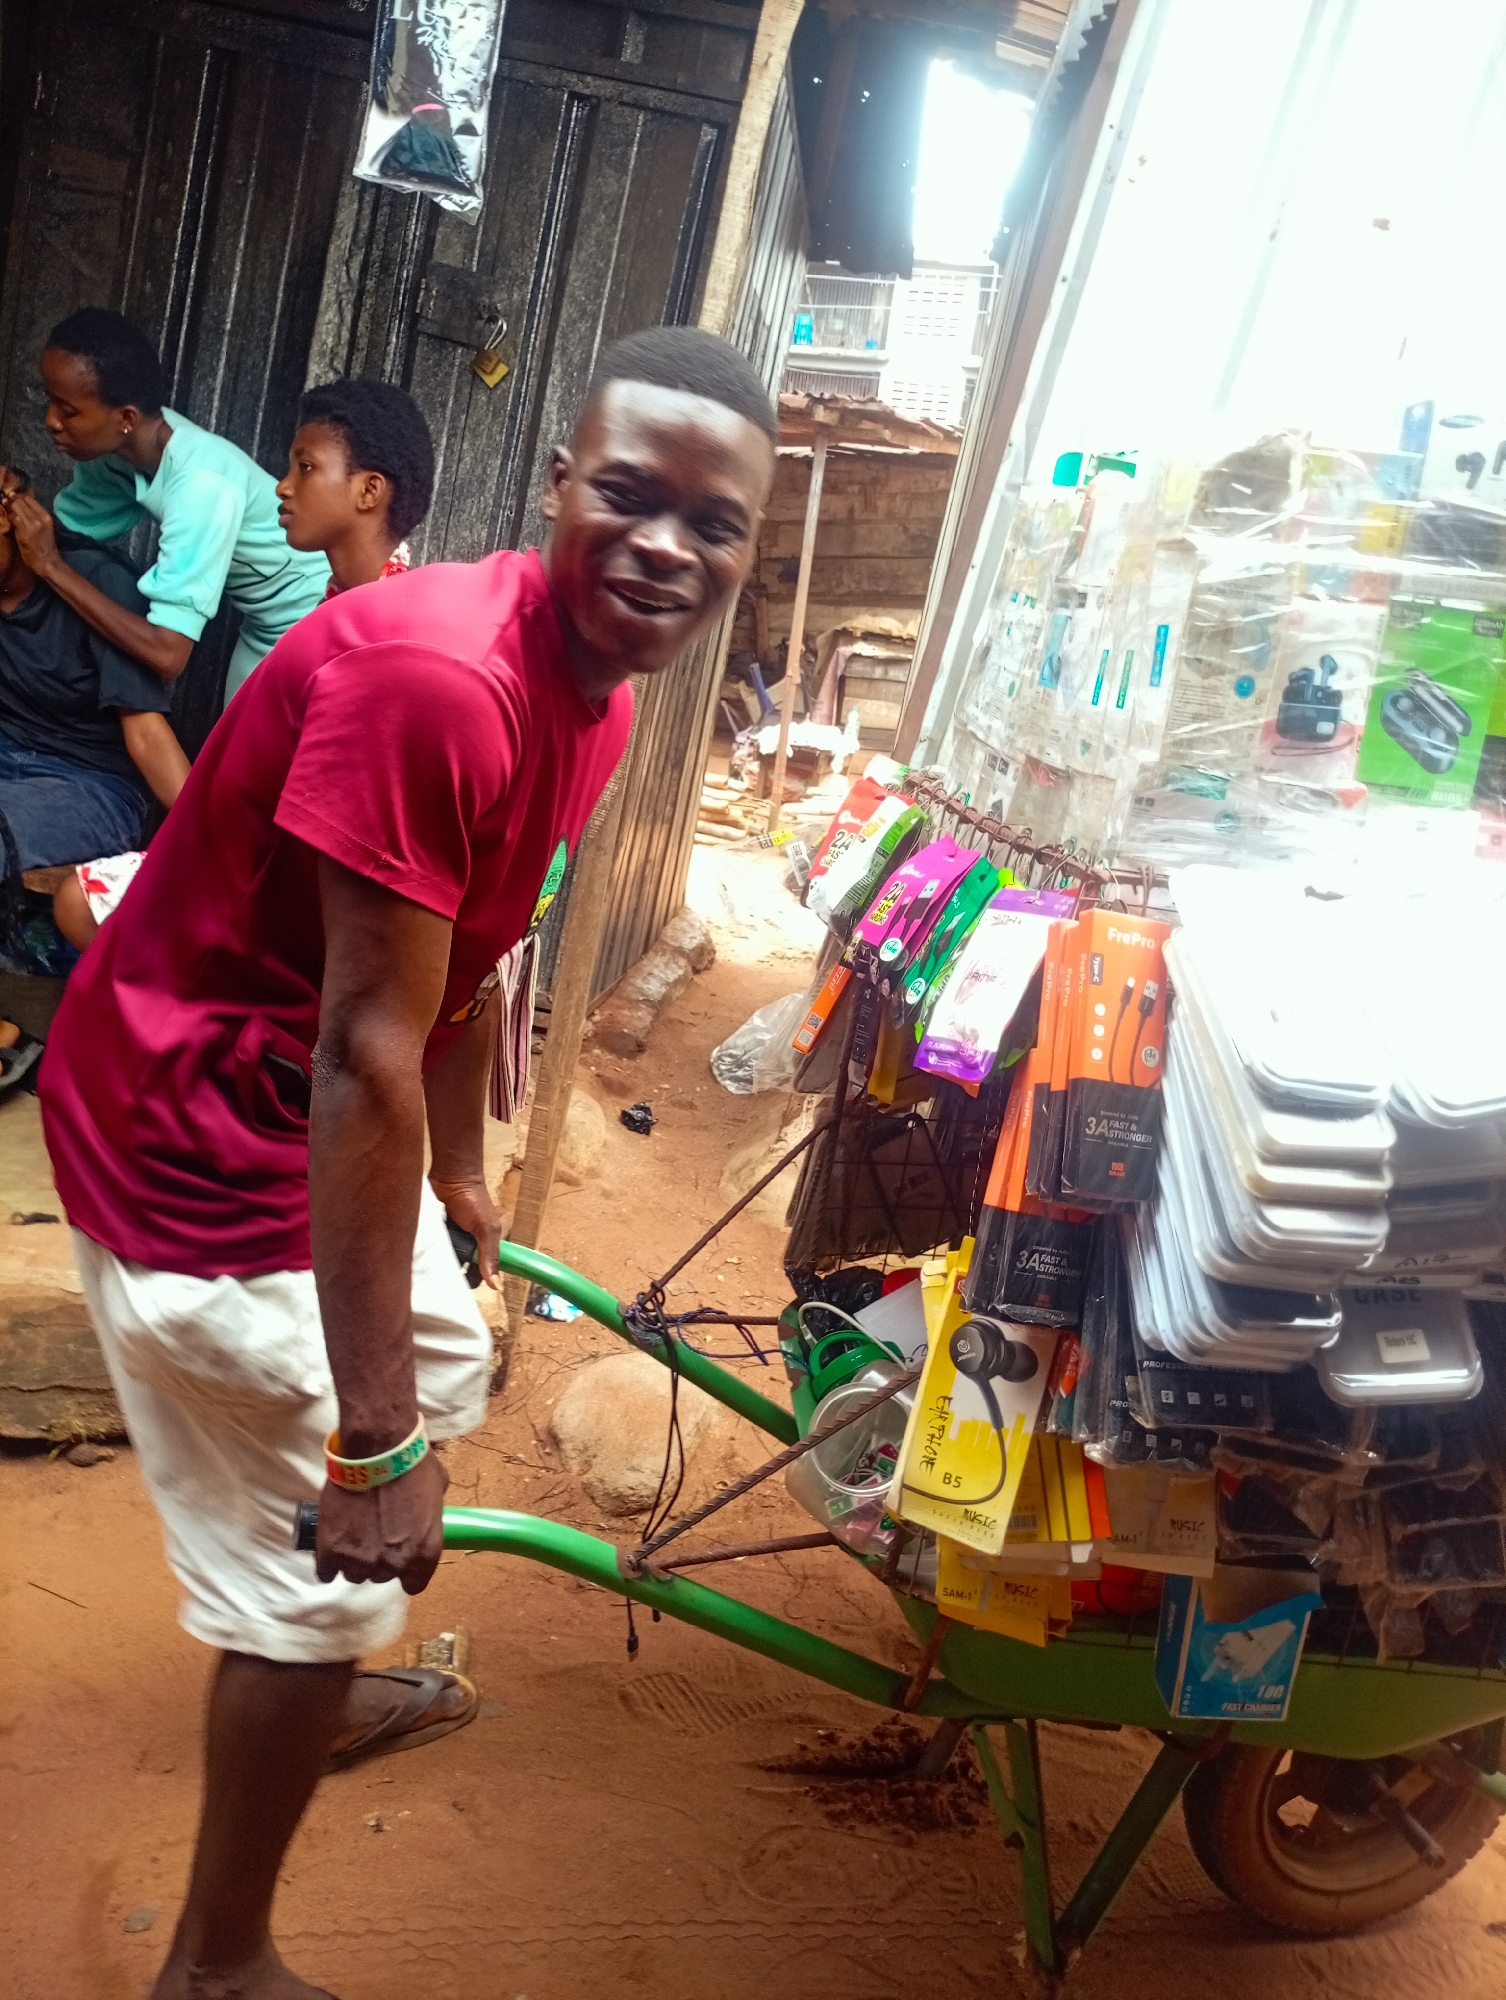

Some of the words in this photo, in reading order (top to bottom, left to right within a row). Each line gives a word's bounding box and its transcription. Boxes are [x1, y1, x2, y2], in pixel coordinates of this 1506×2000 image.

[830, 829, 855, 851] 2A
[1107, 926, 1156, 949] FrePro
[1092, 955, 1101, 983] Type-C
[1085, 1116, 1109, 1137] 3A
[1109, 1120, 1129, 1130] FAST
[1108, 1130, 1153, 1143] STRONGER
[1015, 1249, 1040, 1272] 3A
[1040, 1254, 1061, 1265] FAST
[942, 1471, 962, 1489] B5
[963, 1507, 998, 1530] MUSIC
[942, 1587, 971, 1600] SAM-1
[1222, 1702, 1243, 1712] FAST
